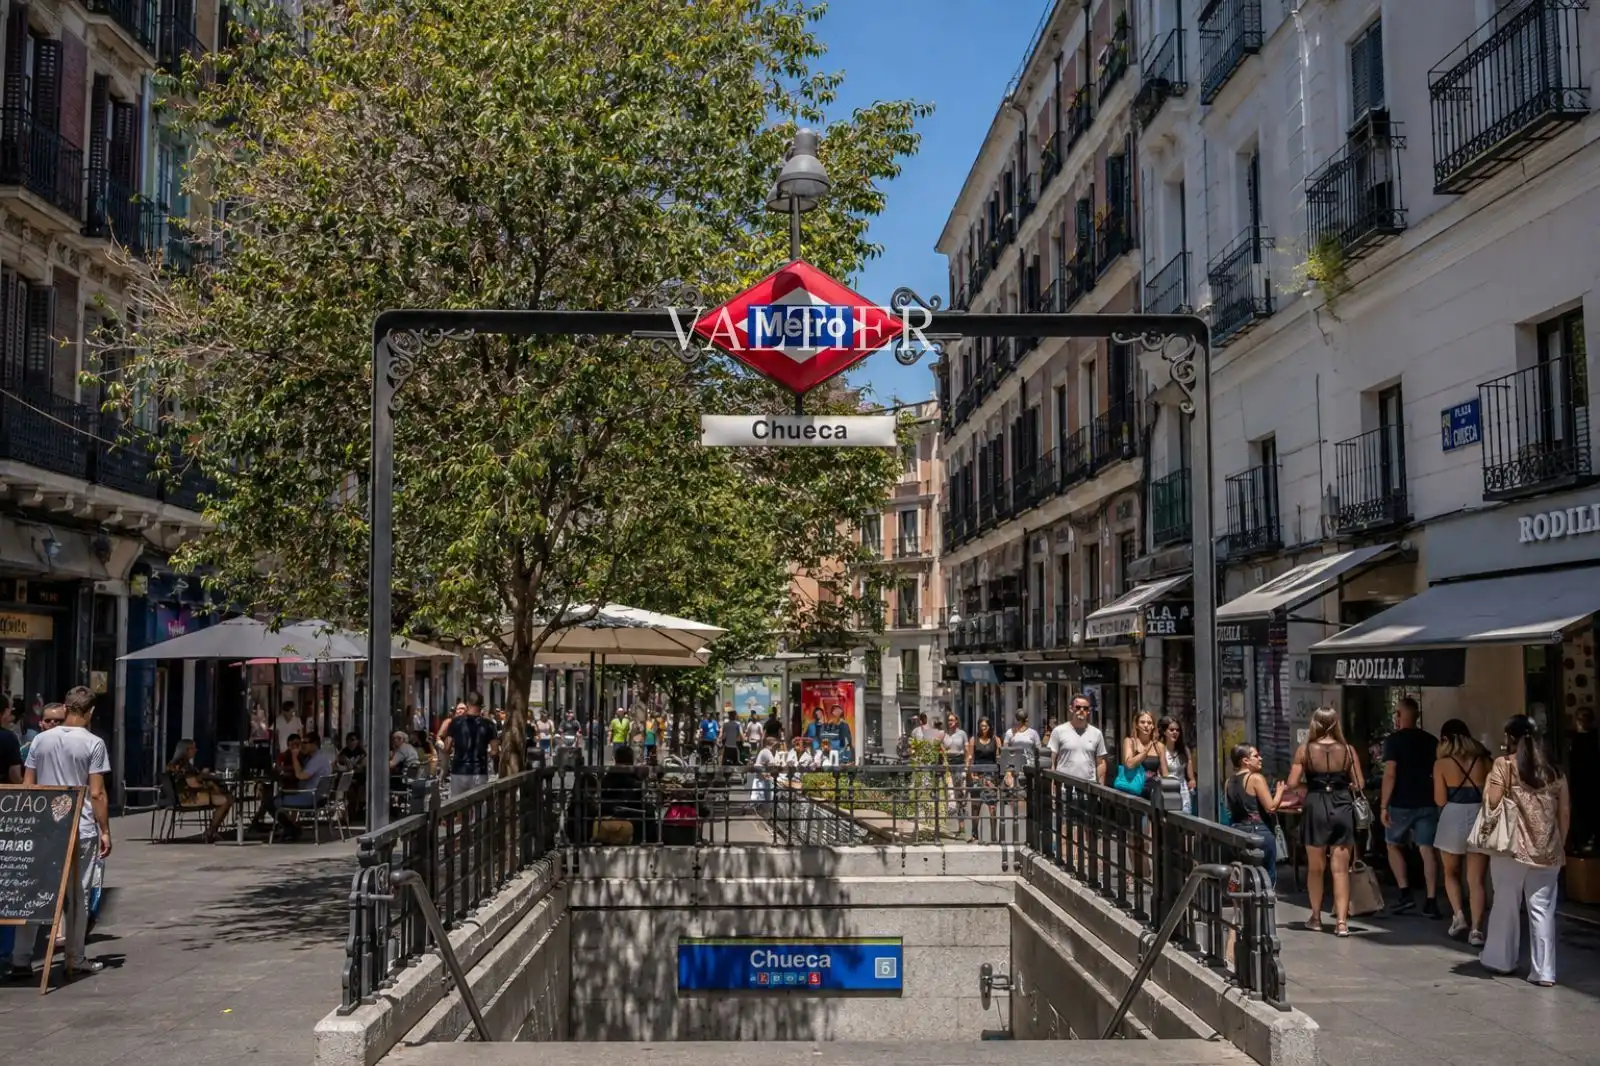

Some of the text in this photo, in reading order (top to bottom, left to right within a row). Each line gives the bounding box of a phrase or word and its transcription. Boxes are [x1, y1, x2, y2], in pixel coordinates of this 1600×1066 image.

[756, 311, 847, 337] Metro
[752, 419, 848, 440] Chueca
[1348, 657, 1405, 679] RODILLA
[0, 794, 48, 813] CIAO
[750, 950, 831, 968] Chueca
